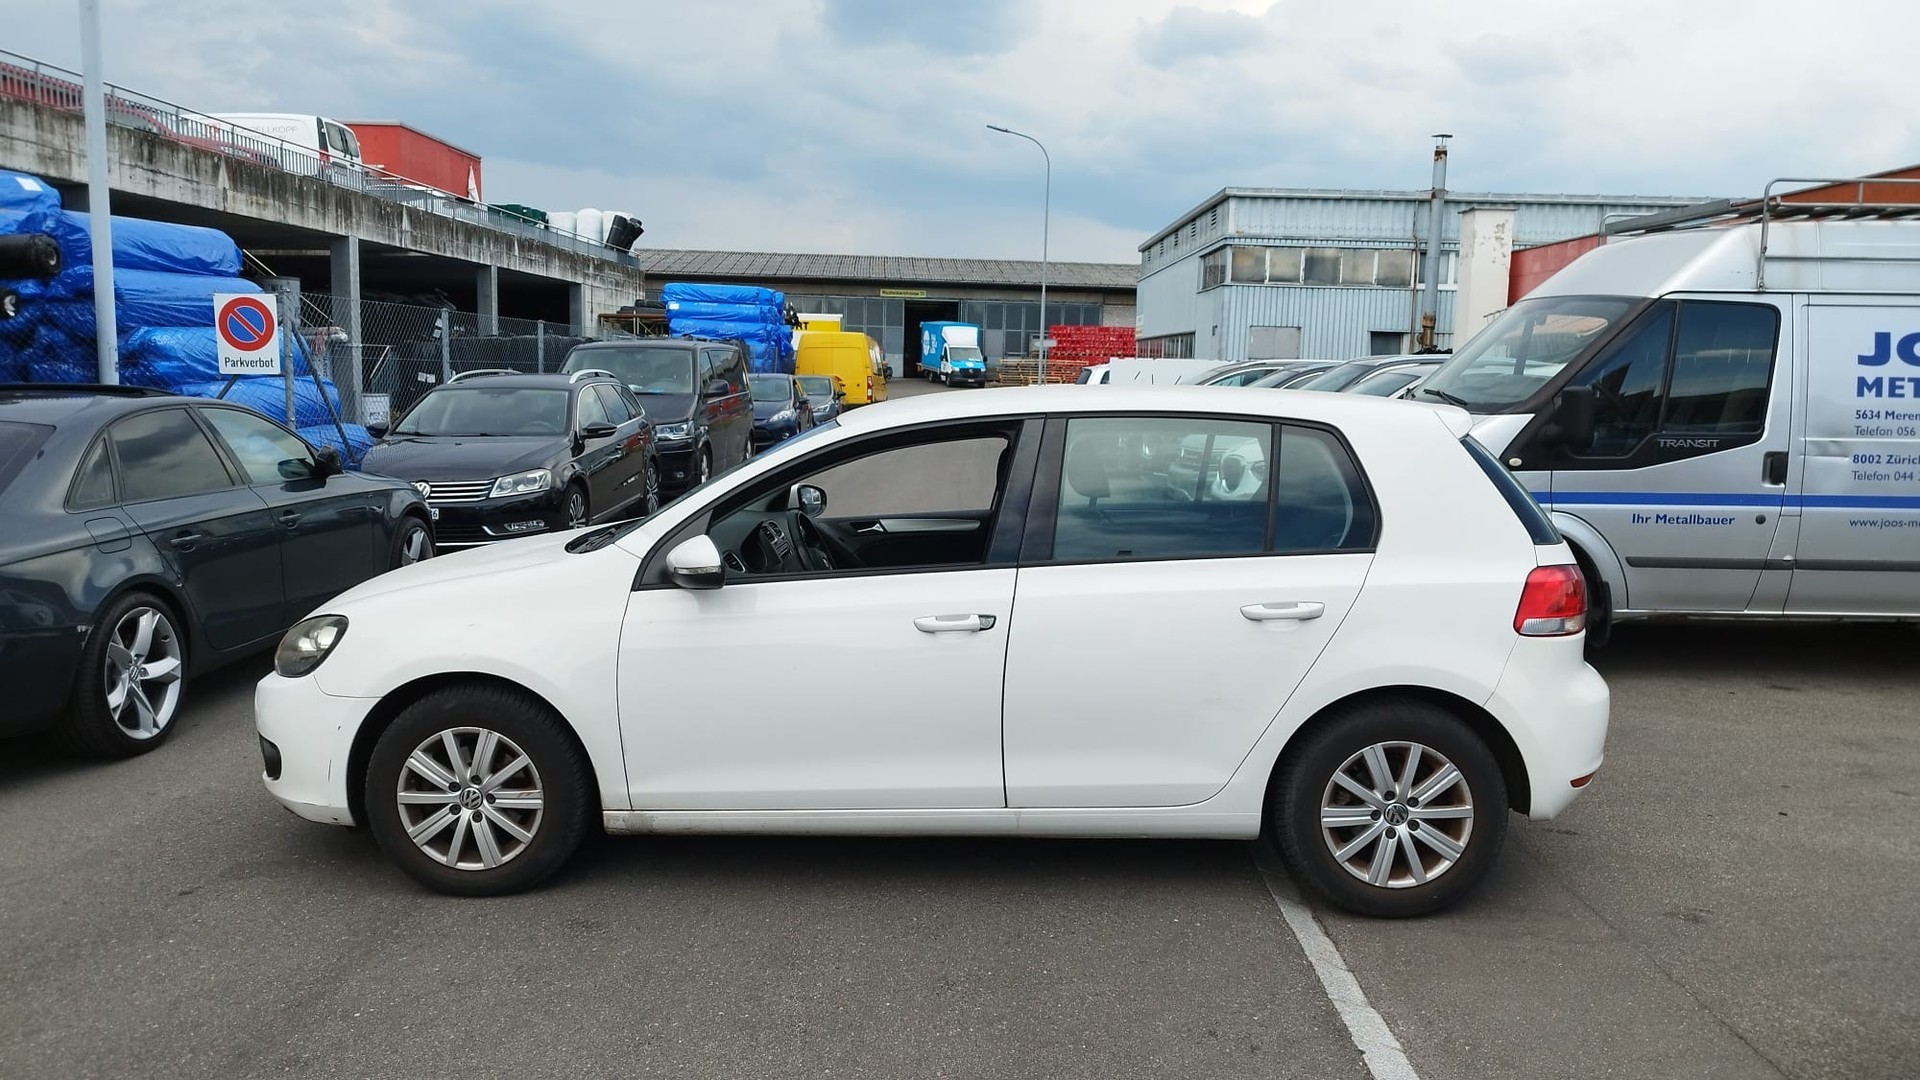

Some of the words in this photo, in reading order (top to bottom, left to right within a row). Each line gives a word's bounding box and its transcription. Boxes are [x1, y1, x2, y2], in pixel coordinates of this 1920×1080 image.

[224, 356, 274, 368] Parkverbot
[1857, 376, 1920, 398] MET
[1855, 409, 1881, 420] 5634
[1854, 425, 1893, 436] Telefon
[1896, 426, 1916, 437] 056
[1658, 439, 1720, 448] TRANSIT
[1852, 453, 1882, 465] 8002
[1886, 454, 1920, 465] Züric
[1851, 470, 1890, 481] Telefon
[1893, 471, 1914, 481] 044
[1631, 513, 1652, 524] Ihr
[1655, 513, 1736, 525] Metallbauer
[1849, 518, 1920, 530] www.joos-m
